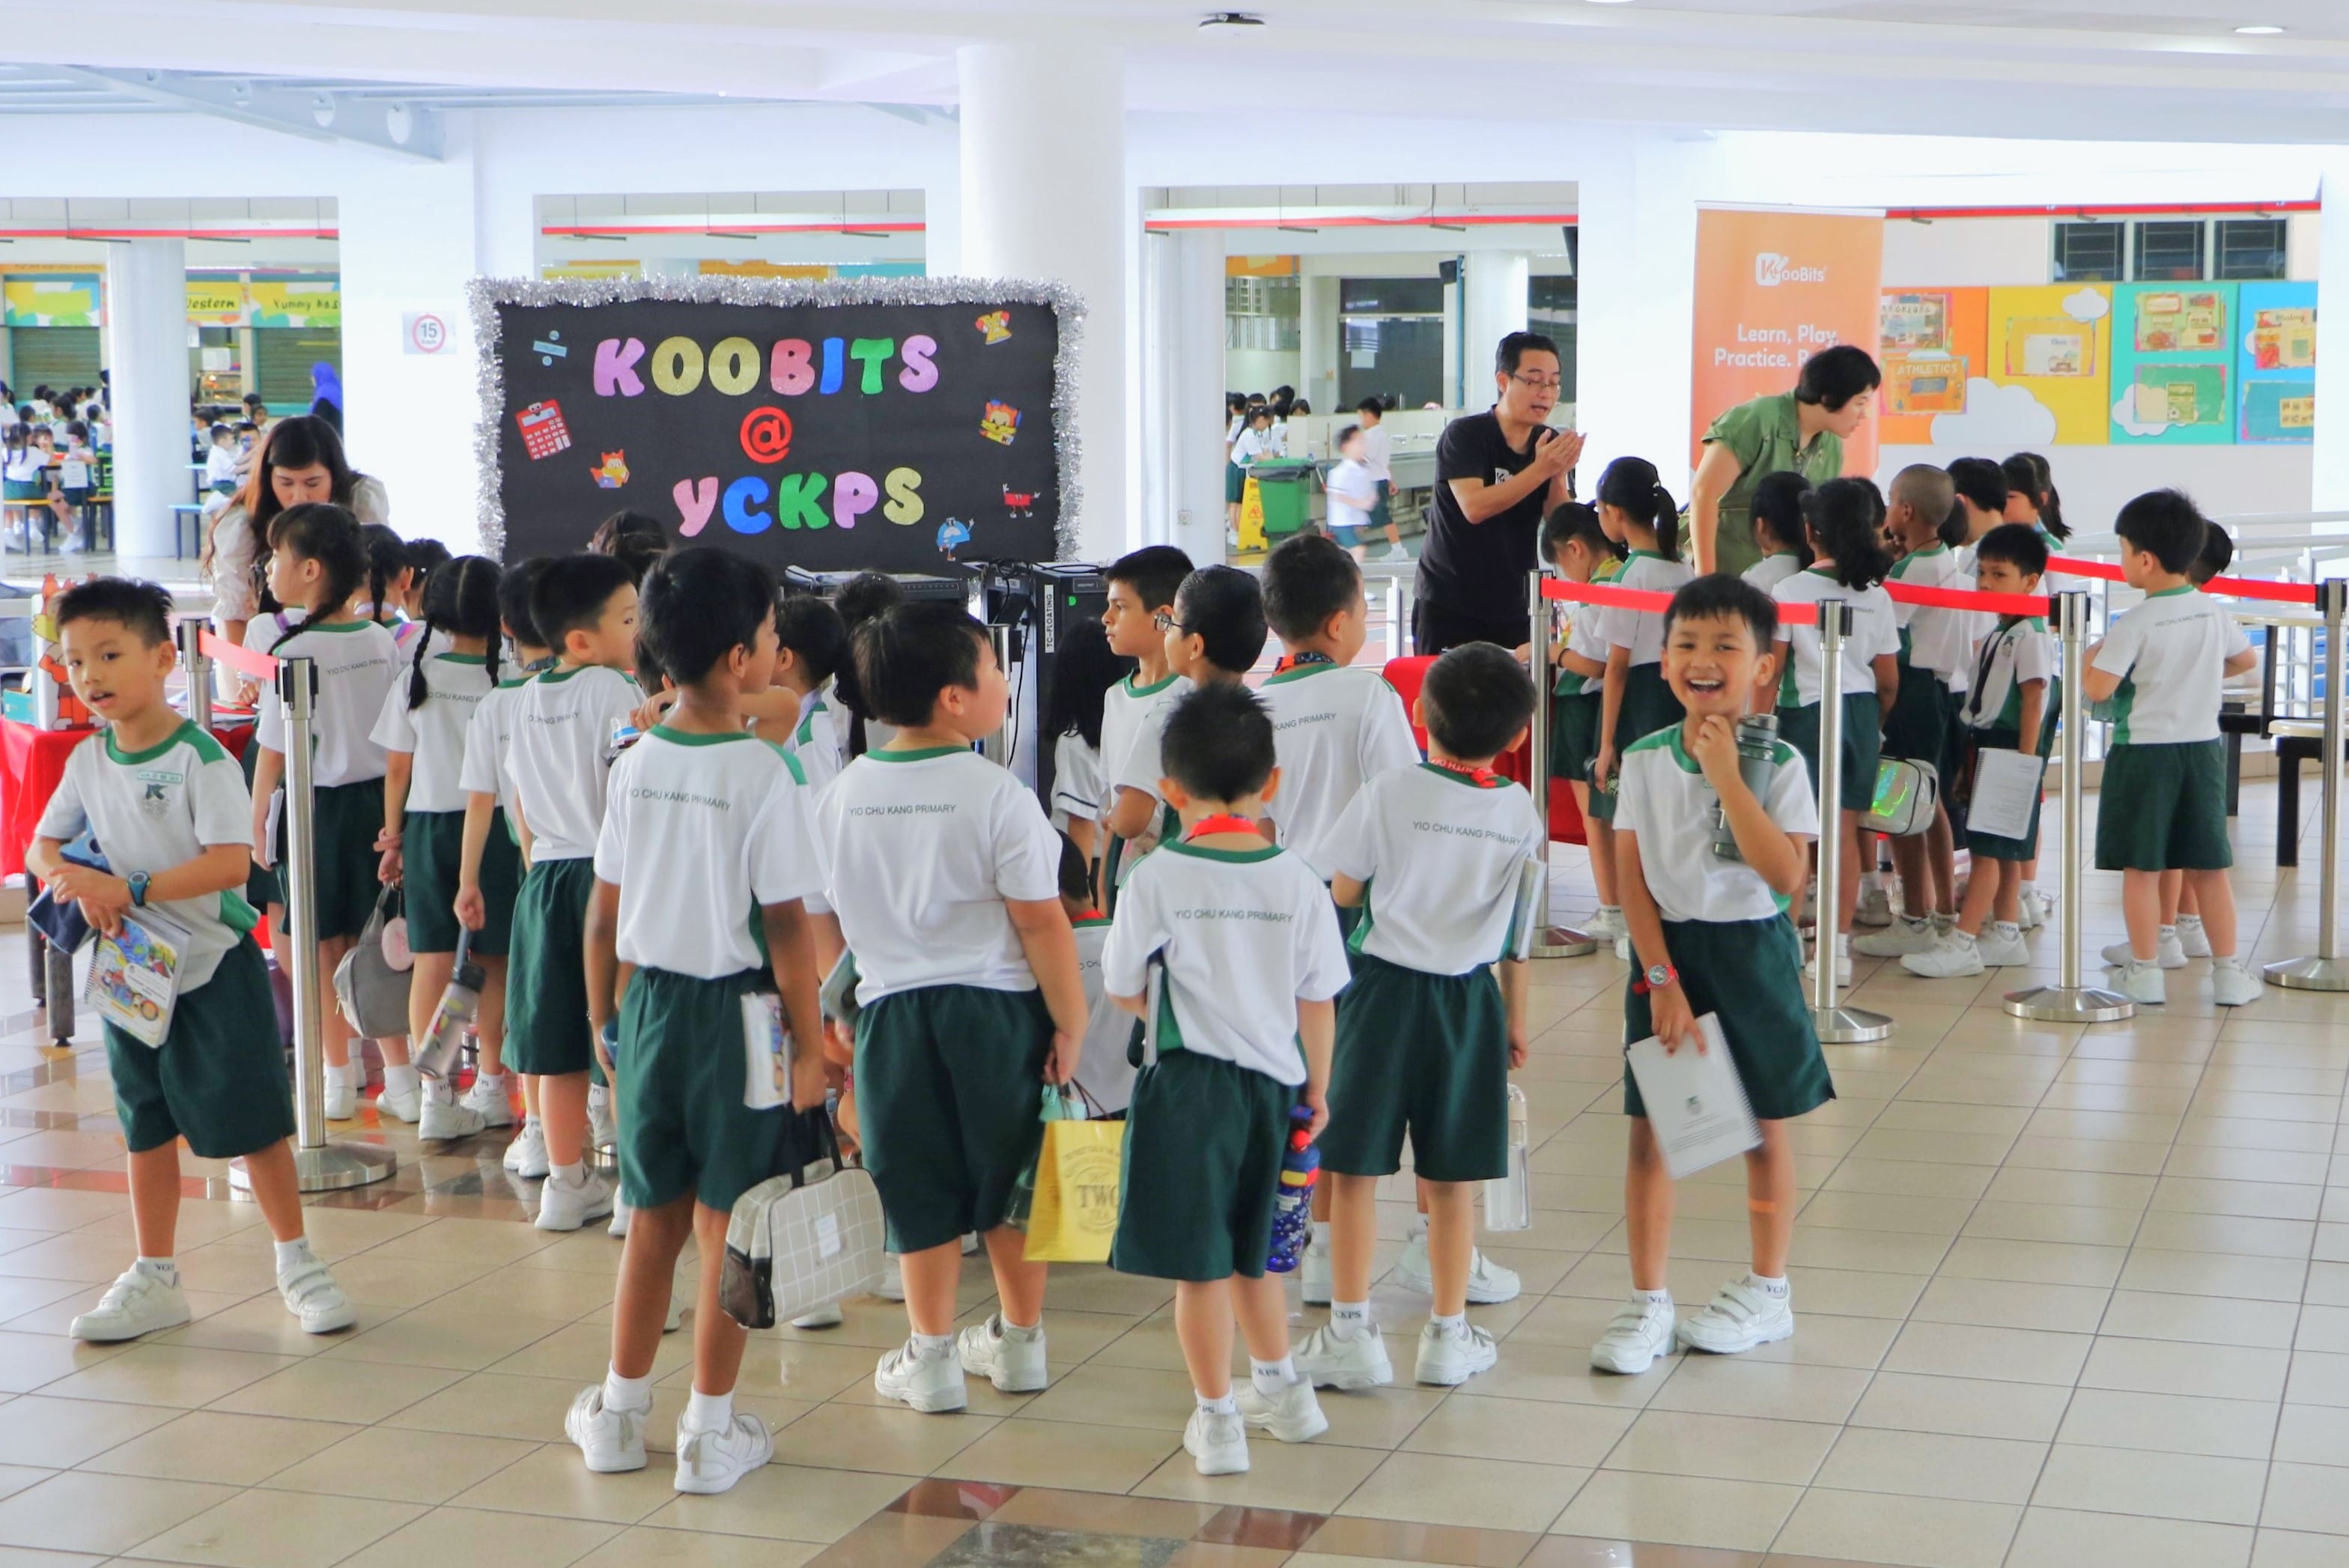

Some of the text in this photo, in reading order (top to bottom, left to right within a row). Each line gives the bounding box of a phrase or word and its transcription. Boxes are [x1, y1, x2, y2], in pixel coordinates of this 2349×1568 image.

[1756, 252, 1825, 285] KooBits
[421, 323, 437, 338] 15
[1737, 323, 1791, 344] Learn,
[593, 334, 939, 397] KOOBITS
[1715, 347, 1791, 366] Practice.
[1897, 363, 1957, 374] ATHLETICS
[739, 407, 792, 464] @
[452, 693, 474, 702] KANG
[1298, 713, 1336, 726] PRIMARY
[642, 788, 662, 799] CHU
[664, 791, 690, 803] KANG
[690, 794, 731, 811] PRIMARY
[850, 803, 956, 816] YIO CHU KANG PRIMARY
[1413, 821, 1522, 845] YIO CHU KANG PRIMARY
[1174, 909, 1293, 923] YIO CHU KANG PRIMARY
